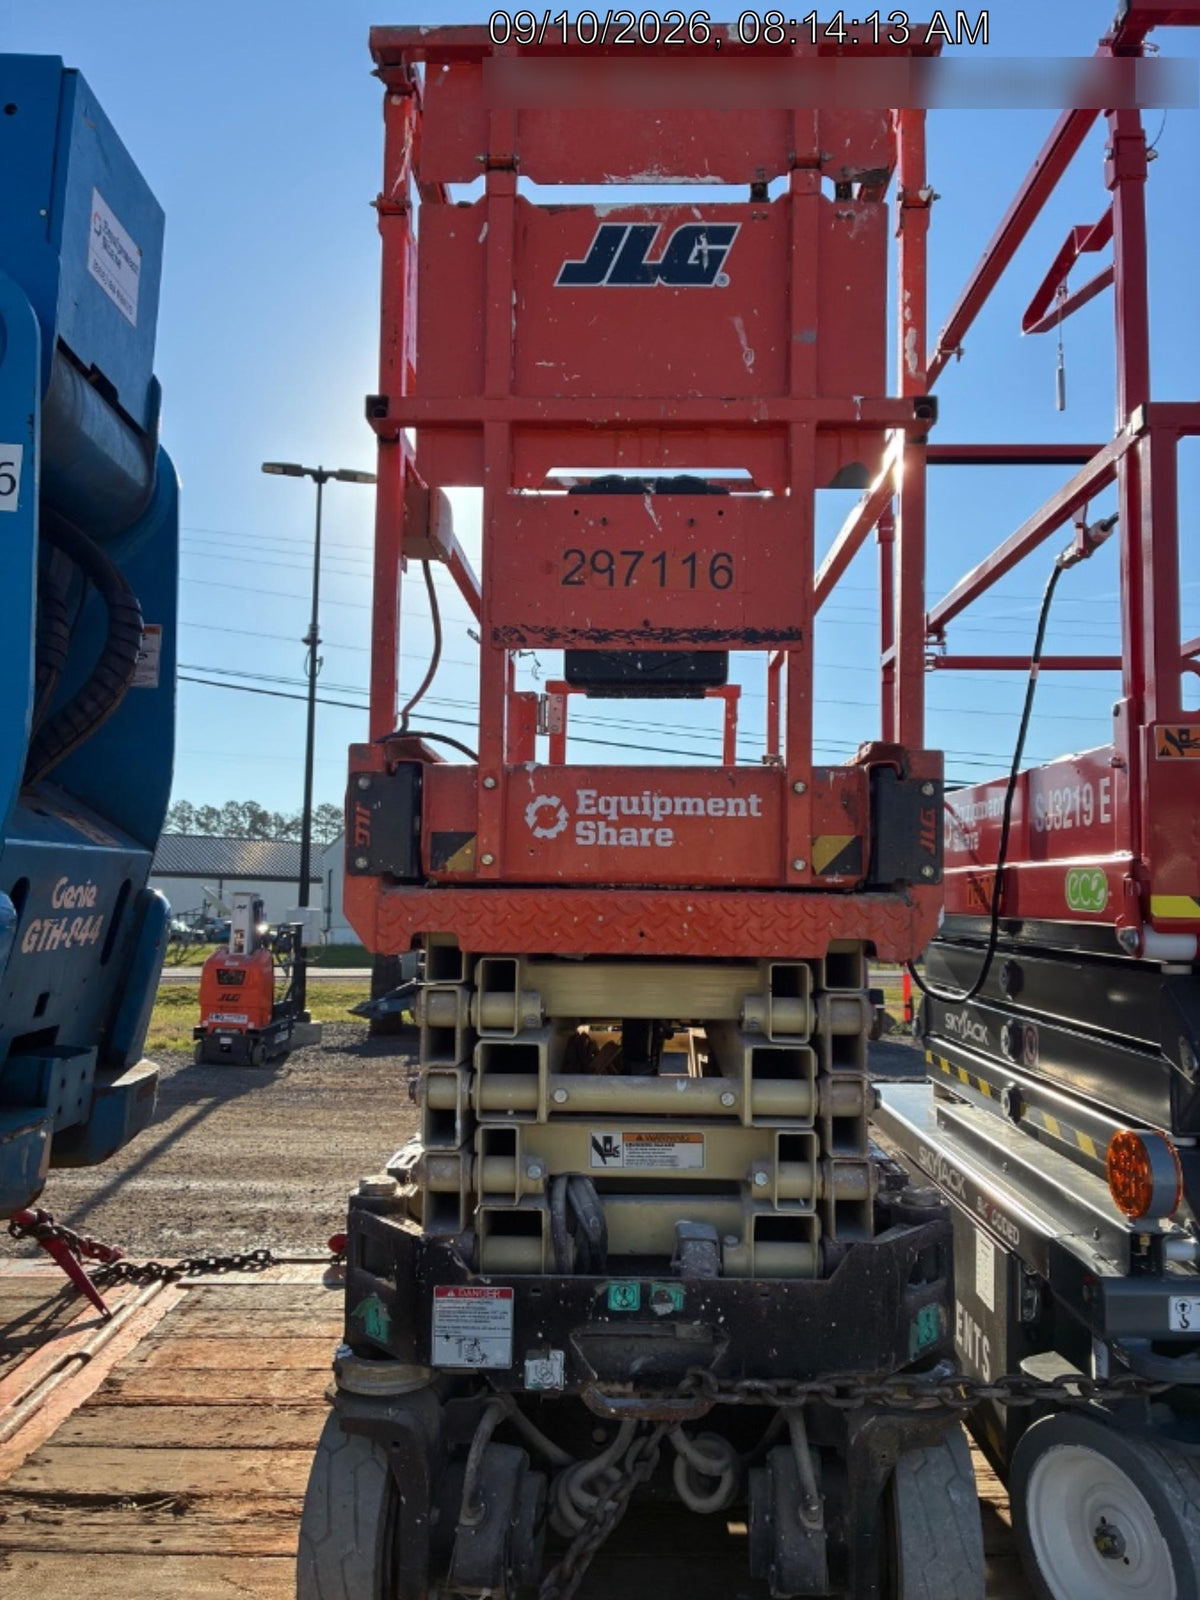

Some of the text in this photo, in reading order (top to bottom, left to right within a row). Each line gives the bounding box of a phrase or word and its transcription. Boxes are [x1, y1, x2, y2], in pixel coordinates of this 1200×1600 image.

[553, 222, 742, 287] JLG
[561, 549, 734, 590] 297116
[353, 801, 371, 848] JLG
[575, 788, 763, 822] Equipment
[1035, 776, 1112, 833] SJ3219 E
[575, 820, 675, 848] Share
[920, 807, 937, 856] JLG
[52, 876, 97, 909] Genie
